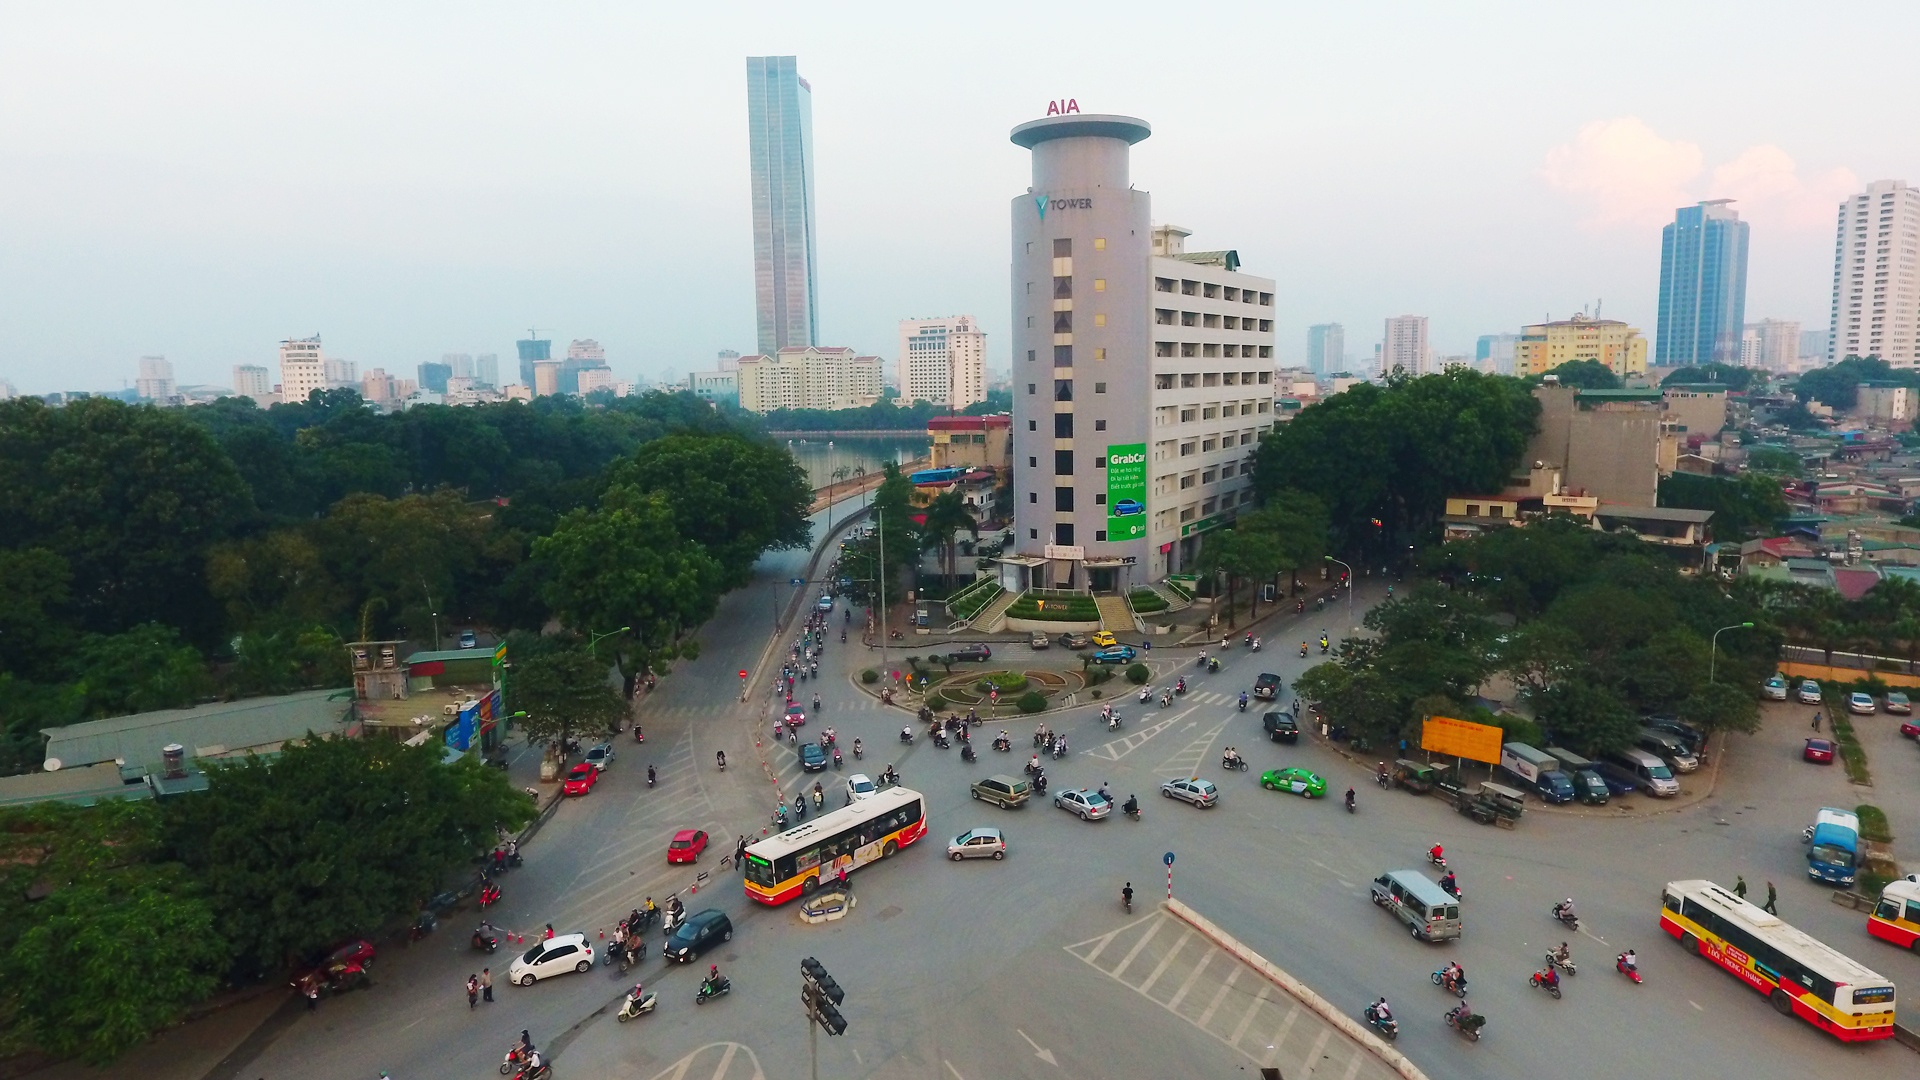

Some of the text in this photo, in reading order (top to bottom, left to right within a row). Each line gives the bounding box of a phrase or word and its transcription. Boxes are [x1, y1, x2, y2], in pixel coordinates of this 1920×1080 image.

[1047, 98, 1080, 116] AIA
[1050, 198, 1092, 210] TOWER
[699, 376, 733, 387] LOTTE
[1110, 453, 1145, 464] GrabCar
